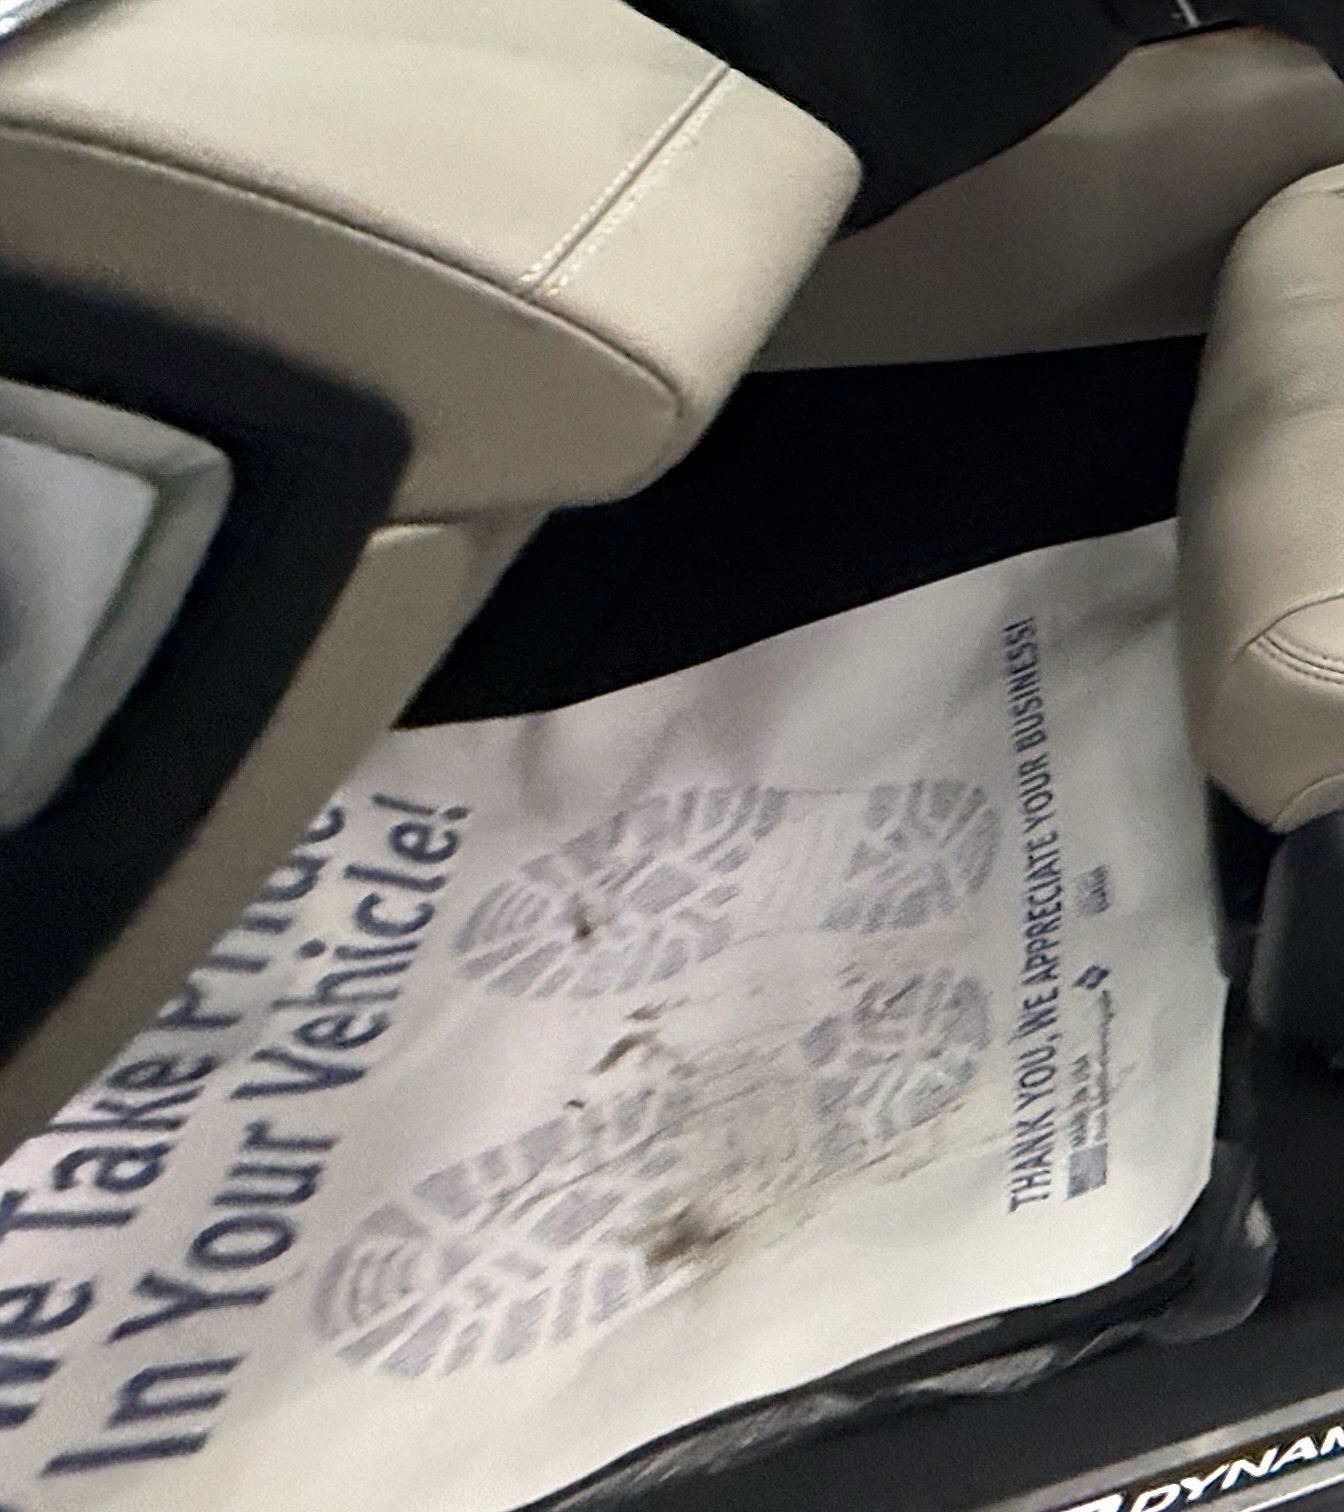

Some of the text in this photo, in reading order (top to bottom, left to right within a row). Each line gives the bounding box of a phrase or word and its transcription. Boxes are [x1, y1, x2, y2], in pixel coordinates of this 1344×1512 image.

[231, 793, 472, 1100] Vehicle!
[1003, 617, 1062, 1212] THANK YOU, WE APPRECIATE YOUR BUSINESS!
[0, 1055, 222, 1239] Take
[107, 1121, 339, 1343] Your
[41, 1354, 246, 1477] In
